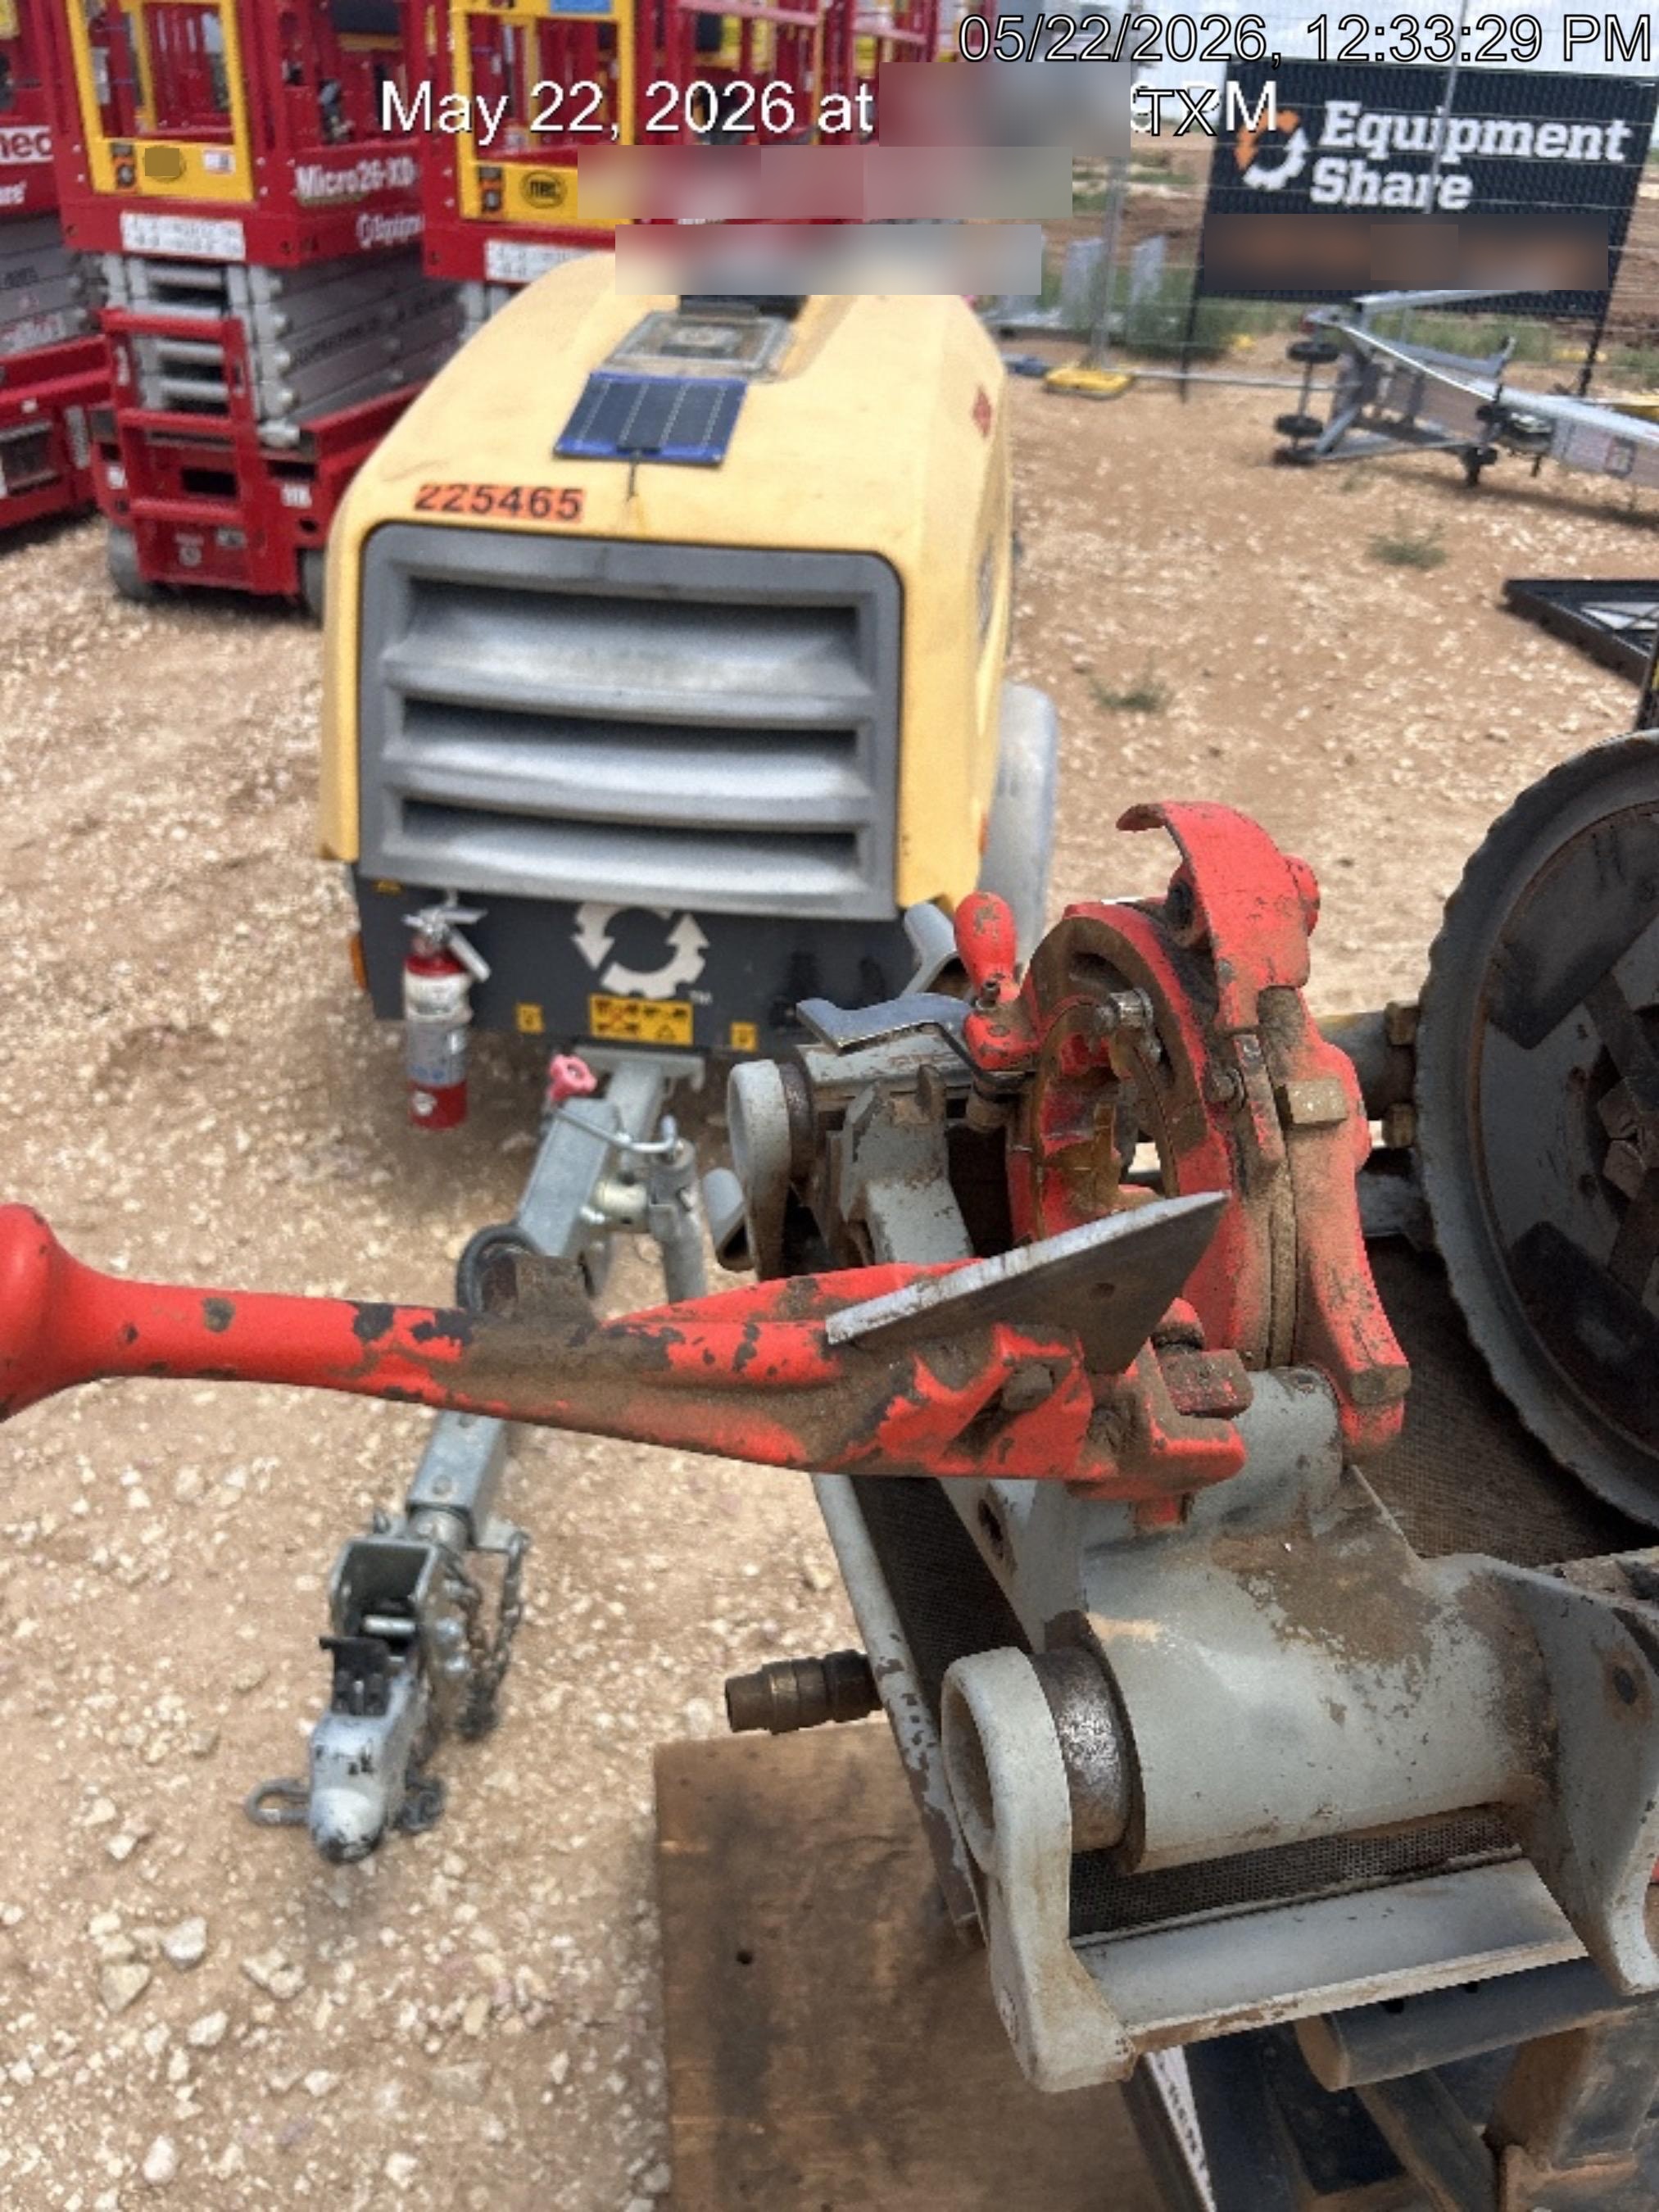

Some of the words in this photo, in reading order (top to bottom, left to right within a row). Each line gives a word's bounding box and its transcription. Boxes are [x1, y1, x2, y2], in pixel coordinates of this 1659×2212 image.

[1319, 100, 1632, 163] Equipment
[1311, 156, 1473, 210] Share
[414, 482, 583, 520] 225465
